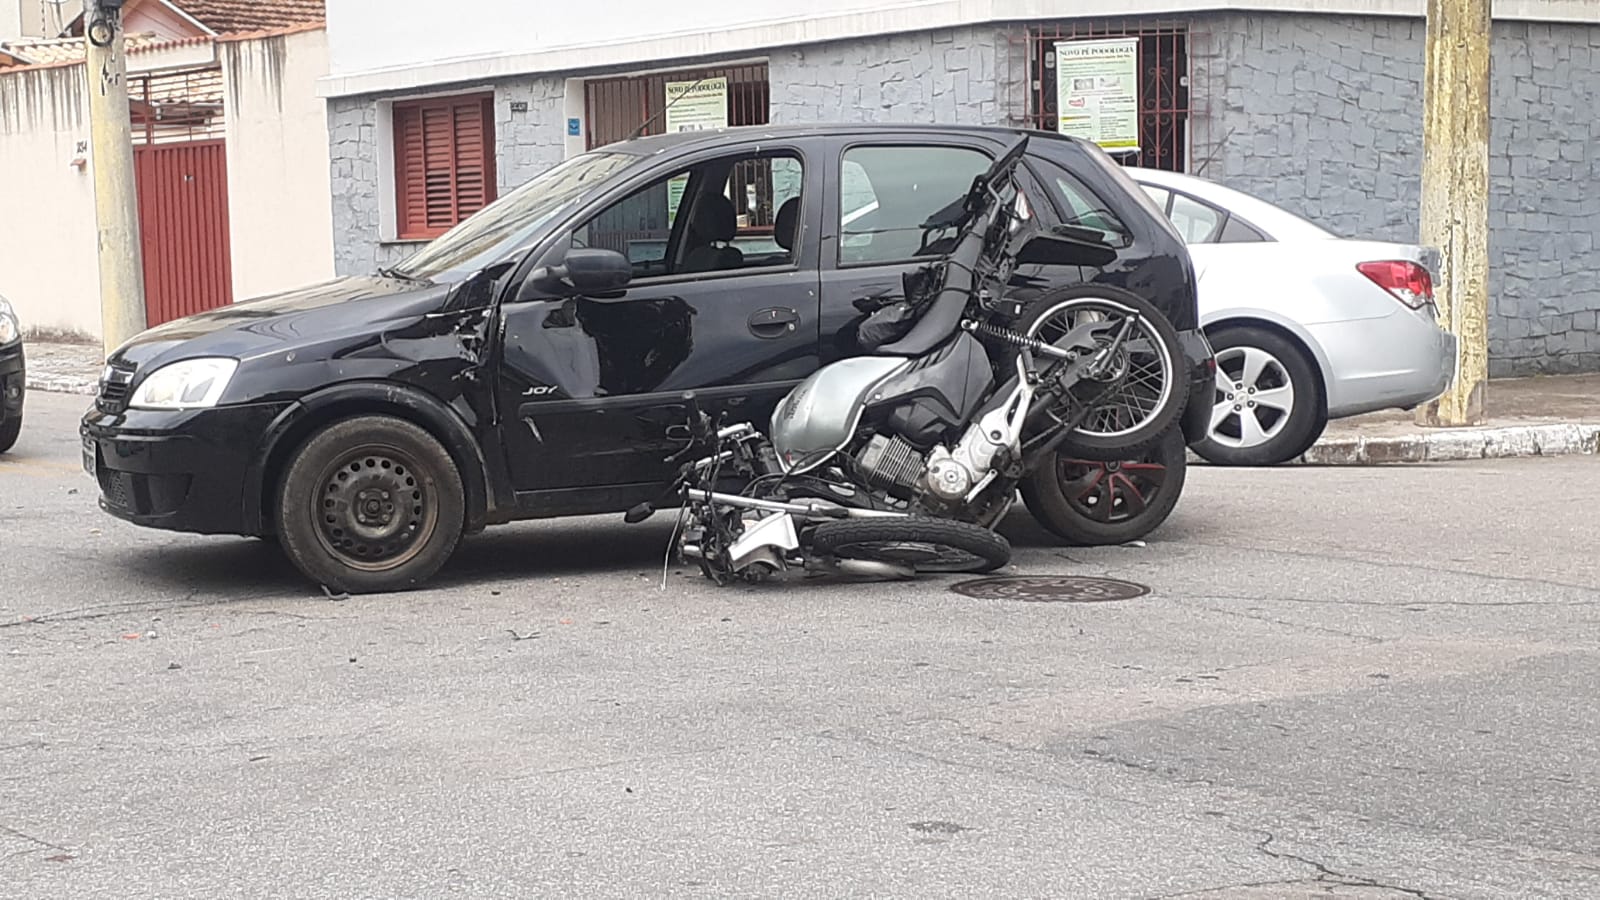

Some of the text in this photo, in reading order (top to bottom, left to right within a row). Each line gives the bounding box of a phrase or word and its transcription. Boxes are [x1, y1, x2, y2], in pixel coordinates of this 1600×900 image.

[1081, 47, 1089, 56] PÉ
[1091, 46, 1134, 55] PODOLOGIA
[521, 385, 558, 395] JOY
